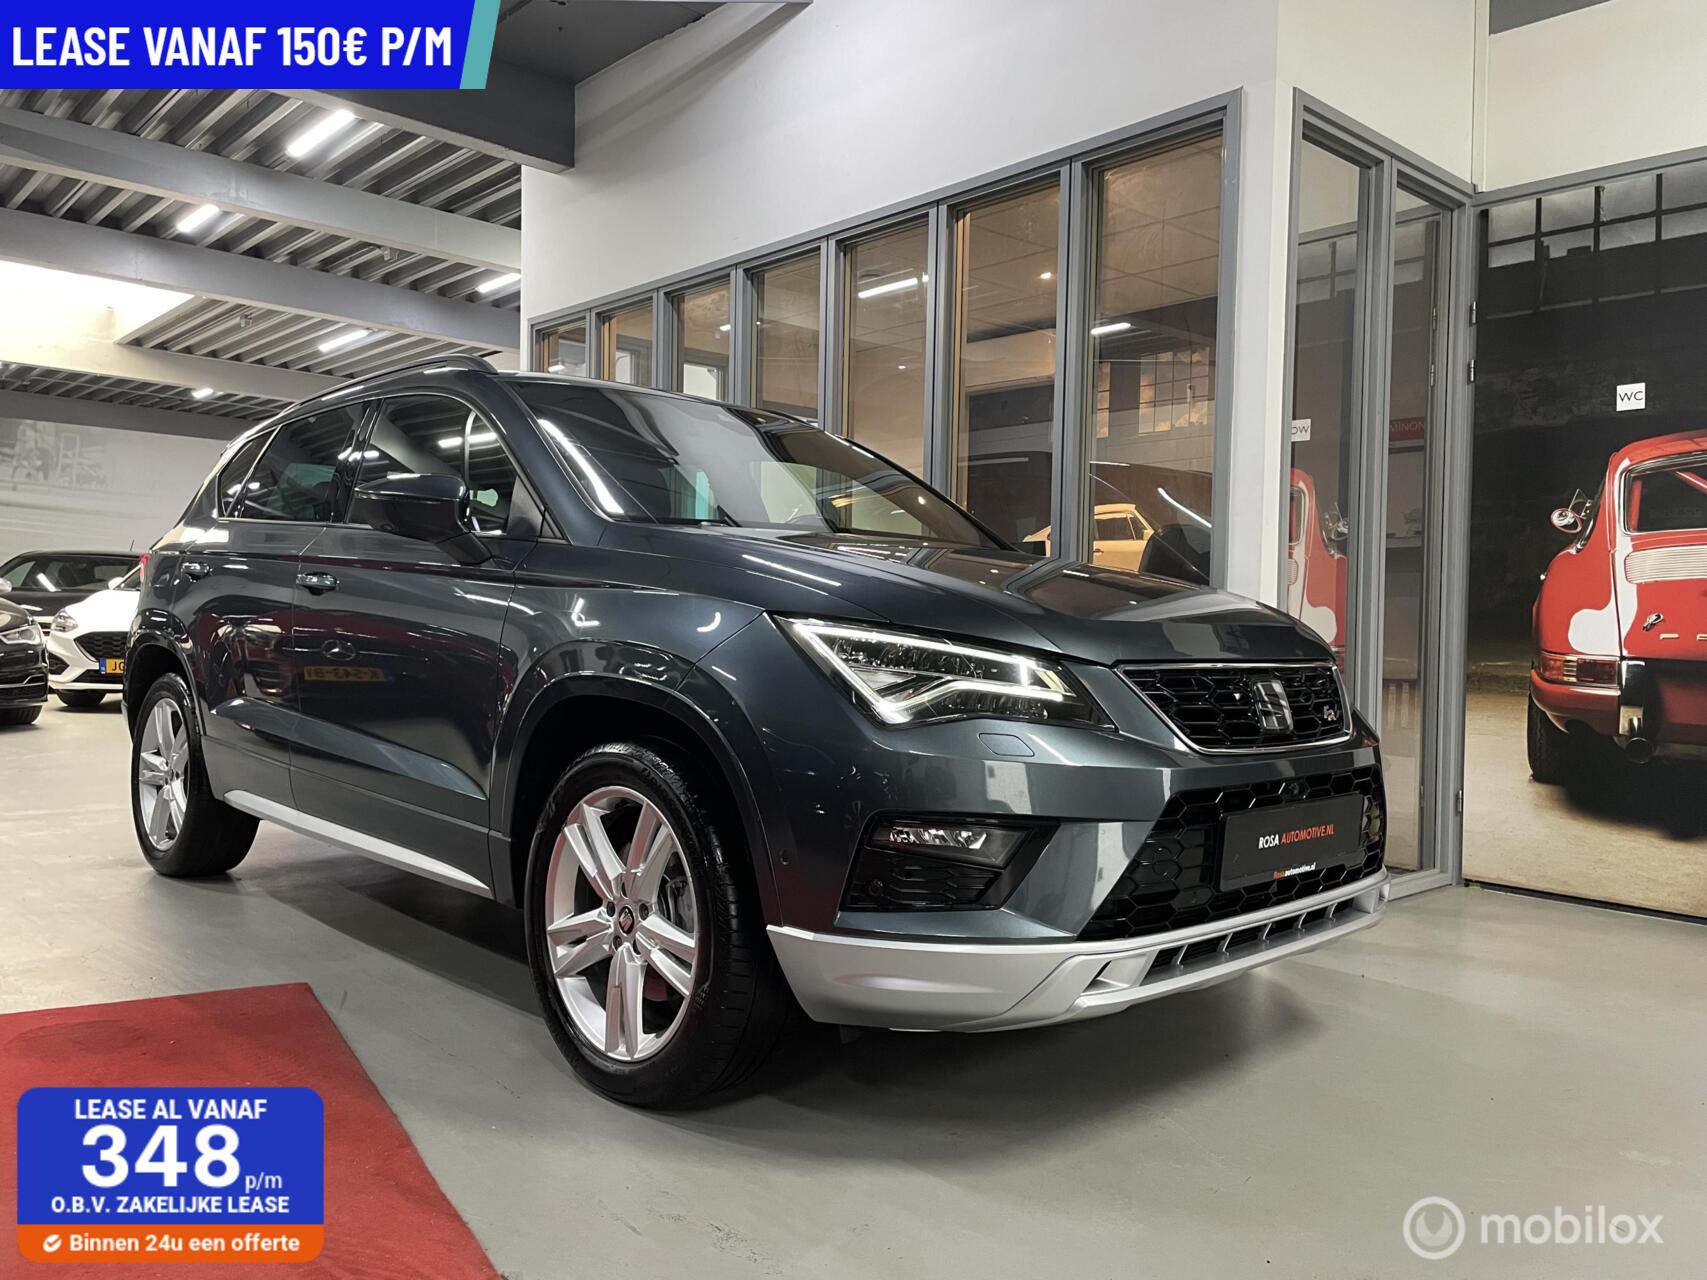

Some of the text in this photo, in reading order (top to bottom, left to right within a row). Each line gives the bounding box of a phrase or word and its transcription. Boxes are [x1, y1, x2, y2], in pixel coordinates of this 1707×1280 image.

[1619, 391, 1643, 402] WC
[1258, 824, 1334, 849] ROSA AUTOMOTIVE.NL
